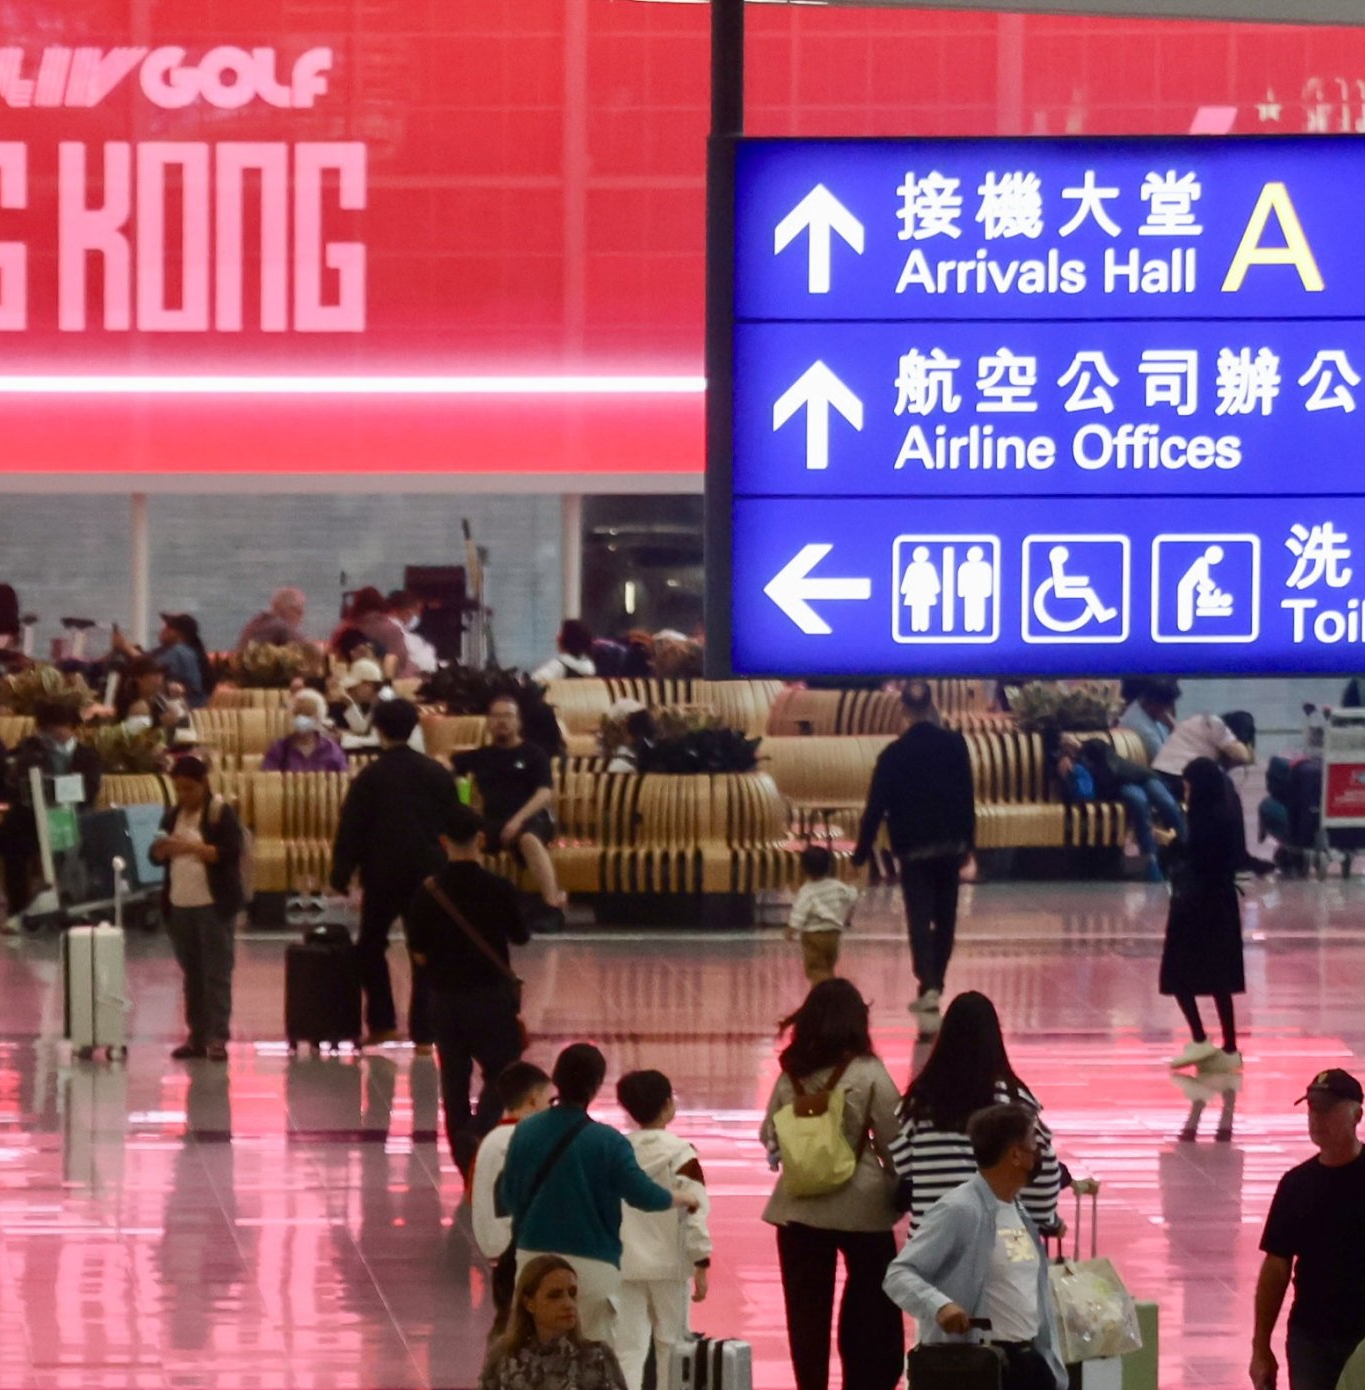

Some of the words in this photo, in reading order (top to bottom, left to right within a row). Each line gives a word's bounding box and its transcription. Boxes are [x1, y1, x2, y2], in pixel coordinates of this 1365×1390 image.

[140, 46, 333, 109] GOLF
[59, 141, 367, 332] KONG
[895, 169, 1204, 241] 接機大堂
[1220, 181, 1325, 292] A
[895, 247, 1087, 294] Arrivals
[1104, 247, 1197, 294] Hall
[893, 424, 1056, 470] Airline
[1072, 423, 1243, 470] Offices
